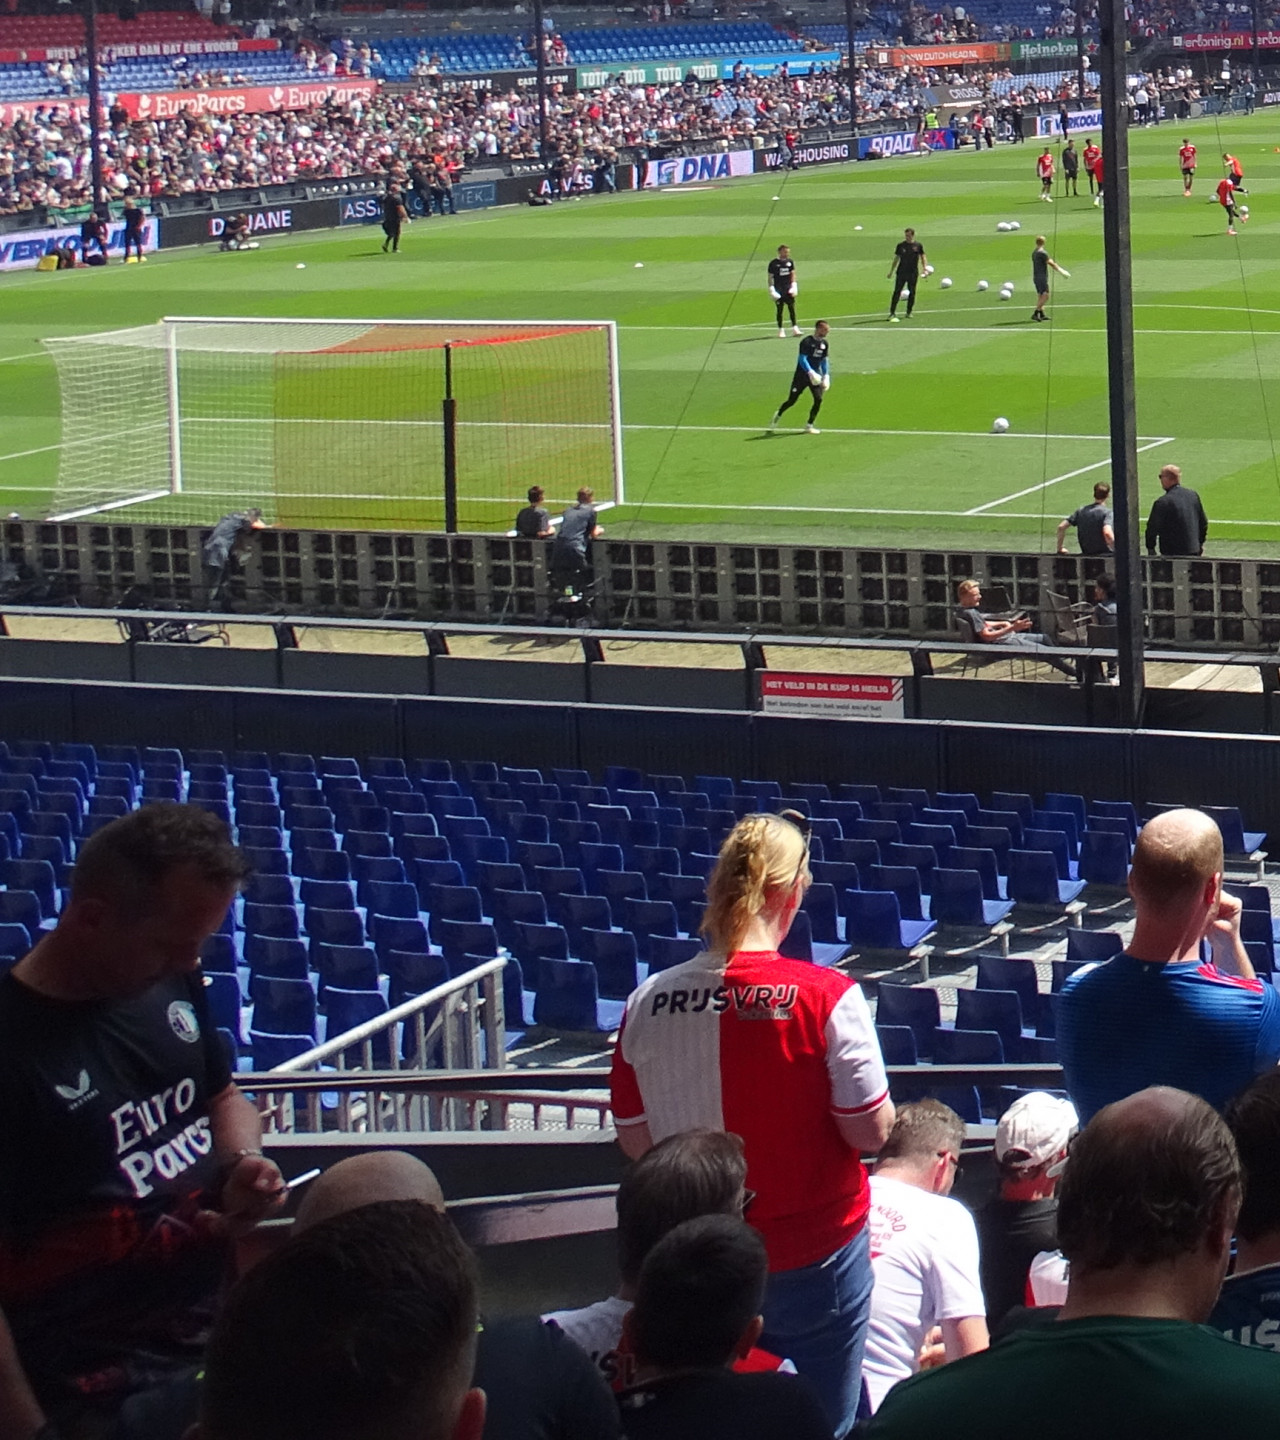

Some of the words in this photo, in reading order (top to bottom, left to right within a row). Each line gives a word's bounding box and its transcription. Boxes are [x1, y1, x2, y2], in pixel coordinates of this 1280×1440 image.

[1184, 36, 1244, 49] erloning.nl
[655, 66, 682, 81] TOTO
[156, 93, 246, 116] EuroParcs
[683, 154, 732, 183] DNA
[651, 984, 799, 1016] PRIJSVRIJ
[111, 1077, 196, 1156] Euro
[120, 1116, 213, 1199] Parcs
